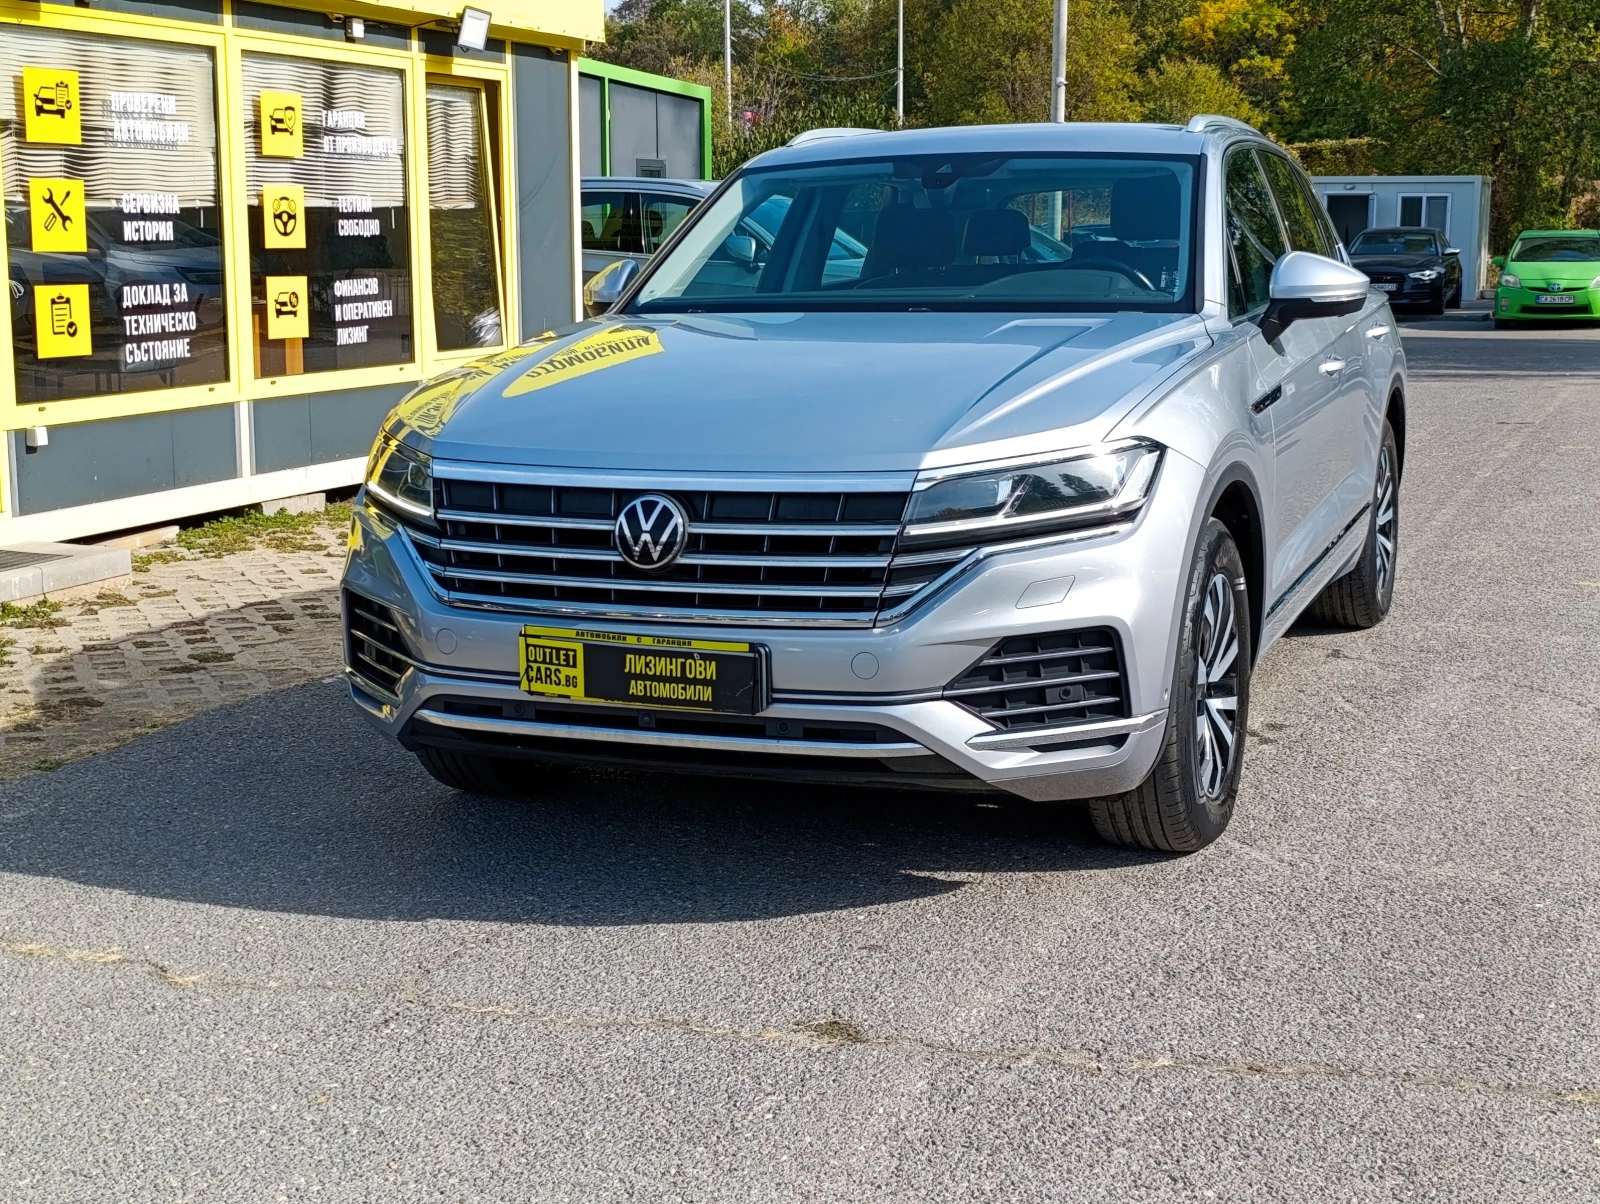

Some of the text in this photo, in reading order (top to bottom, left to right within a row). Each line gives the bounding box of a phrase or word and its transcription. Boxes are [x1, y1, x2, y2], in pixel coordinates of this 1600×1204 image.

[111, 92, 176, 114] ПРОВЕРЕНИ
[113, 119, 189, 142] АВТОМОБИЛИ
[322, 111, 365, 129] ГАРАНЦИЯ
[324, 136, 335, 152] ОТ
[122, 193, 180, 214] СЕРВИЗНА
[338, 193, 372, 213] ТЕСТВАЙ
[123, 221, 174, 242] ИСТОРИЯ
[338, 219, 380, 238] СВОБОДНО
[122, 283, 189, 308] ДОКЛАД ЗА
[334, 277, 379, 297] ФИНАНСОВ
[335, 300, 393, 322] И ОПЕРАТИВЕН
[123, 311, 197, 336] ТЕХНИЧЕСКО
[336, 325, 369, 346] ЛИЗИНГ
[125, 338, 191, 364] СЪСТОЯНИЕ
[575, 630, 627, 642] АВТОМОБИЛИ
[652, 638, 692, 647] ГАРАНЦИЯ
[527, 646, 575, 666] OUTLET
[527, 664, 578, 689] CARS.BG
[624, 653, 717, 681] ЛИЗИНГОВИ
[628, 679, 713, 702] АВТОМОБИЛИ
